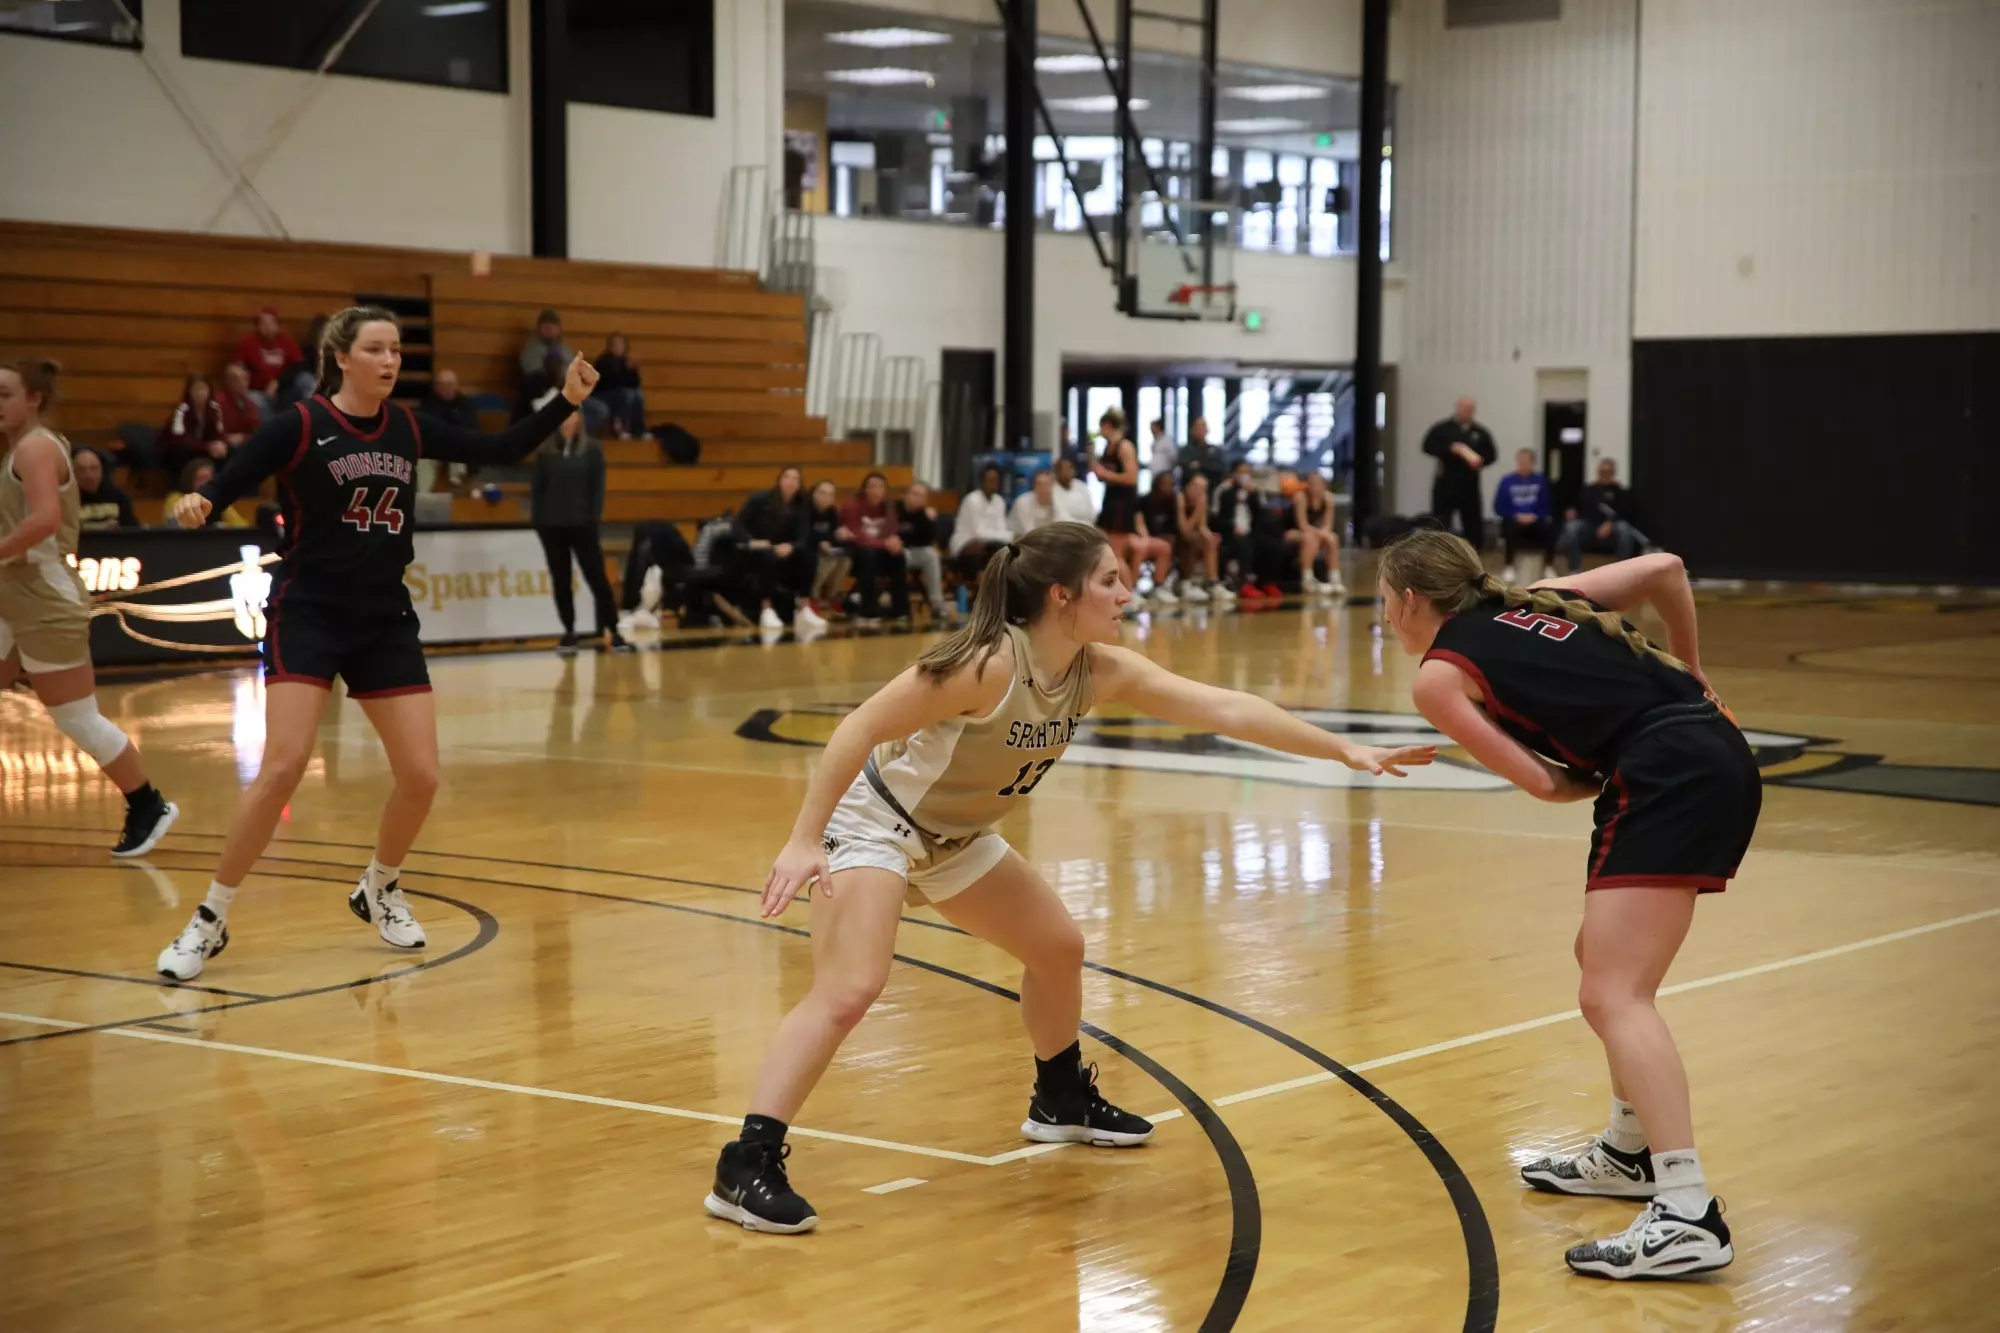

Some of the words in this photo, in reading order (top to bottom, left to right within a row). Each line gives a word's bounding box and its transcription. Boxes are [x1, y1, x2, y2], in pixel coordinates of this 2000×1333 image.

[327, 451, 413, 486] PIONEERS
[341, 486, 405, 534] 44
[1493, 607, 1579, 641] 5
[1005, 712, 1081, 749] SPARTAN
[996, 757, 1056, 796] 13
